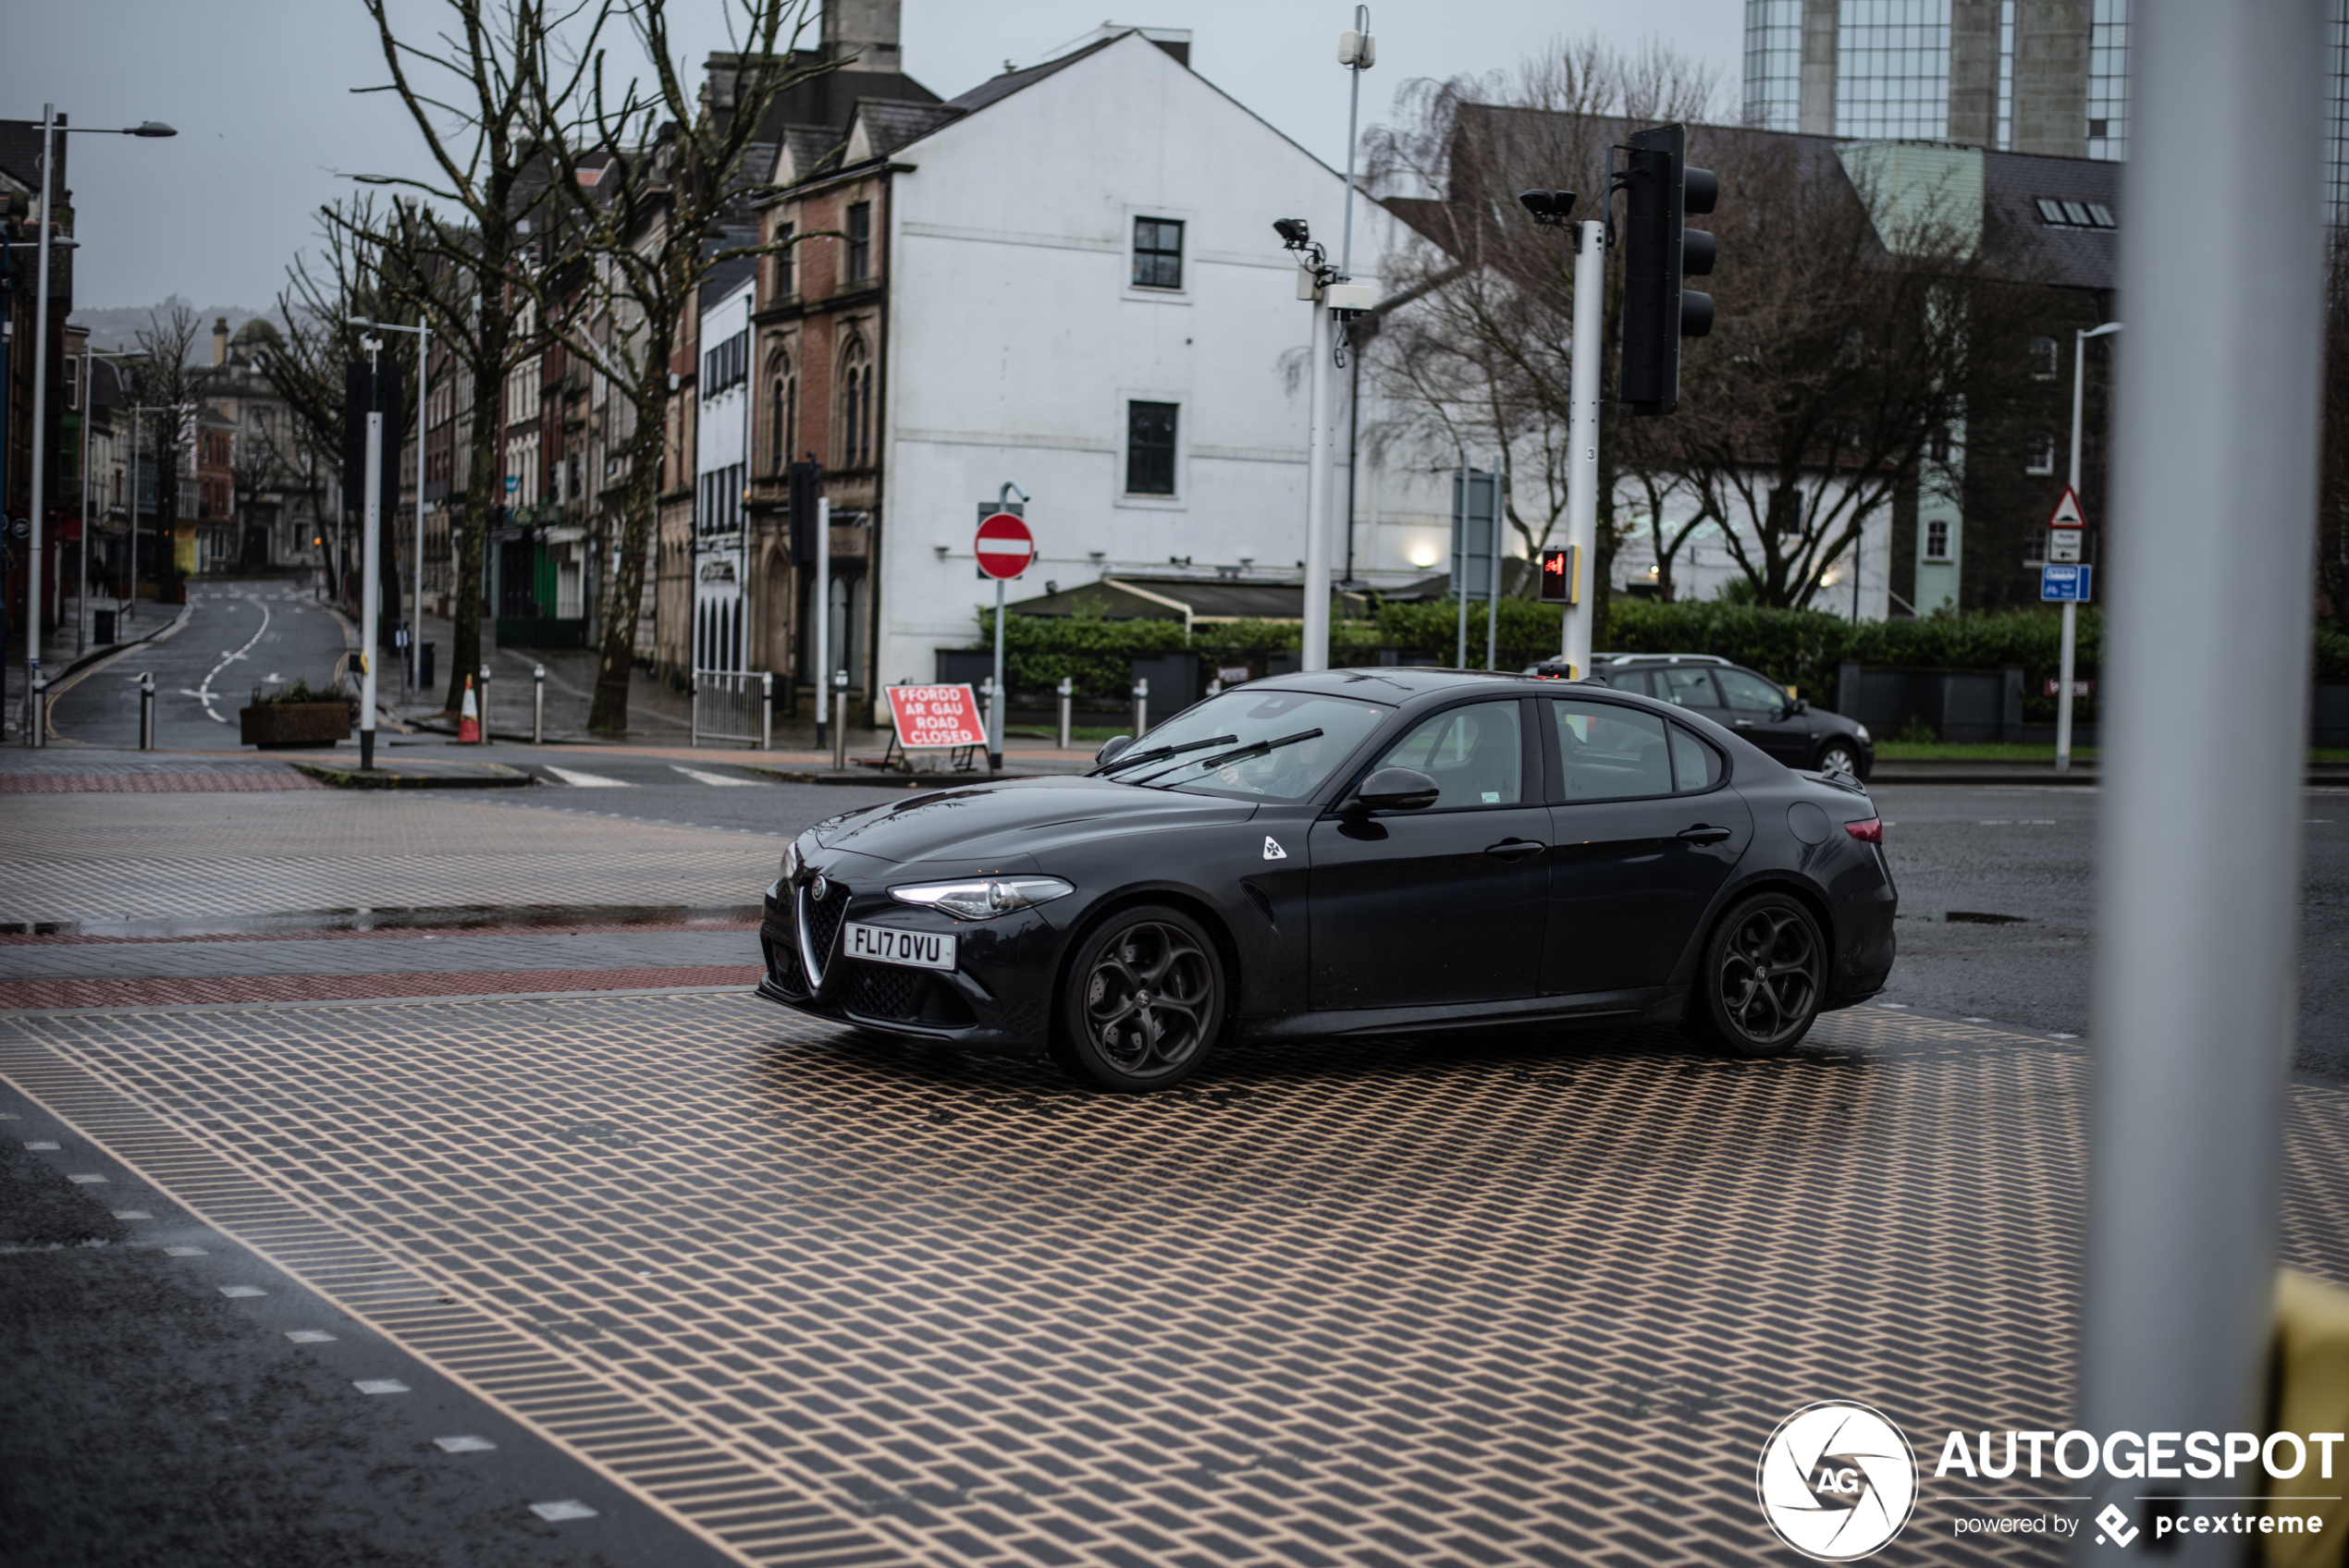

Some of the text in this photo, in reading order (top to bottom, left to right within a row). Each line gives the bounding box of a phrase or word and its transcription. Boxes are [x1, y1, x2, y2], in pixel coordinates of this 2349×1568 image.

[1588, 449, 1595, 459] 3
[899, 688, 961, 702] FFORDD
[905, 702, 964, 716] AR GAU
[916, 717, 959, 729] ROAD
[910, 729, 973, 744] CLOSED
[855, 928, 940, 962] FL17 OVU
